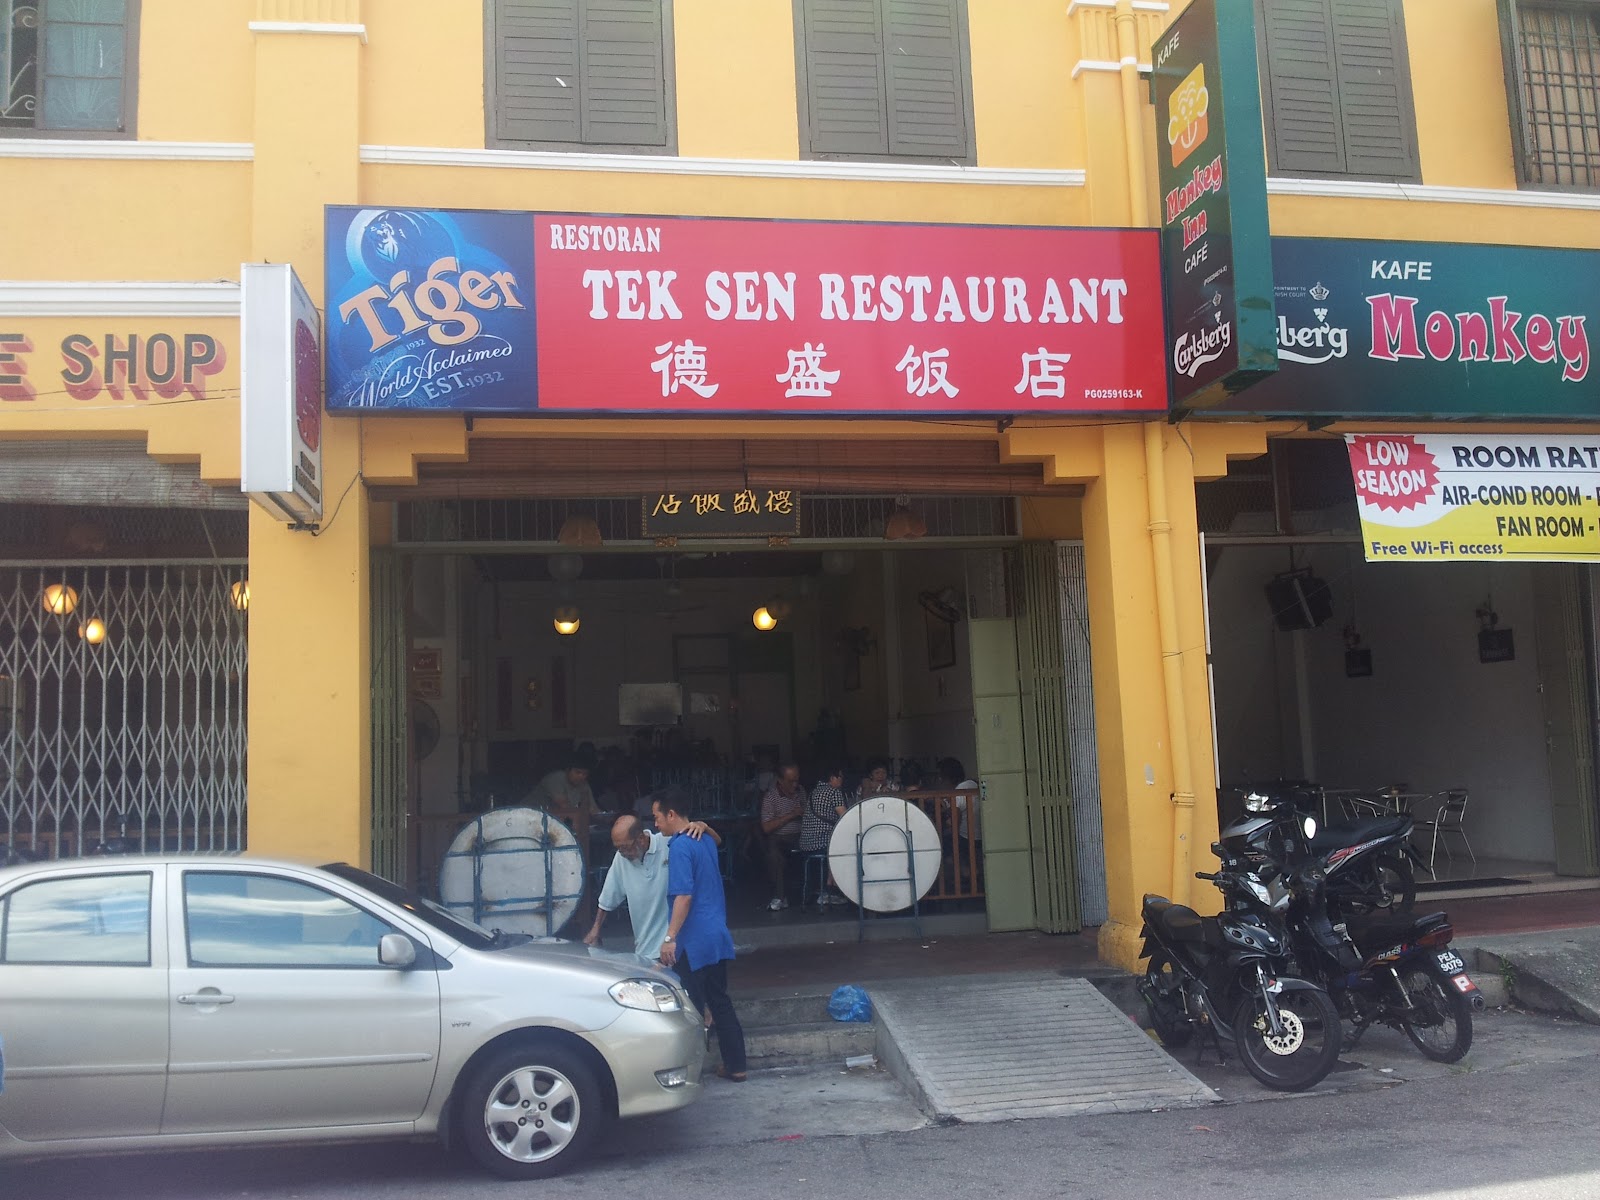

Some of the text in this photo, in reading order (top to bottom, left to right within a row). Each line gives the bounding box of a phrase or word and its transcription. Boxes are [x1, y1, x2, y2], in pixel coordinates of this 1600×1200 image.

[1157, 31, 1180, 68] KAFE
[1166, 155, 1223, 225] Monkey
[550, 224, 661, 252] RESTORAN
[1181, 209, 1208, 252] Inn
[1184, 241, 1208, 274] CAFÉ
[1371, 260, 1432, 280] KAFE
[339, 257, 526, 353] Tiger
[582, 269, 683, 320] TEK
[705, 271, 797, 322] SEN
[819, 273, 1127, 324] RESTAURANT
[406, 338, 426, 351] 1932
[1174, 322, 1231, 376] Carlsberg
[1366, 293, 1590, 382] Monkey
[61, 333, 219, 392] SHOP
[347, 355, 421, 406] World
[408, 337, 512, 386] Acclaimed
[1085, 389, 1143, 399] PG0259163-K
[1365, 440, 1409, 466] LOW
[1452, 446, 1600, 468] ROOM RAT
[1357, 469, 1427, 498] SEASON
[1442, 485, 1527, 506] AIR-COND
[1531, 486, 1582, 506] ROOM
[1496, 516, 1533, 537] FAN
[1537, 516, 1584, 537] ROOM
[1371, 541, 1503, 555] Free Wi-Fi access
[1437, 951, 1456, 964] PEA
[1440, 958, 1463, 972] 9079
[1454, 976, 1470, 992] P
